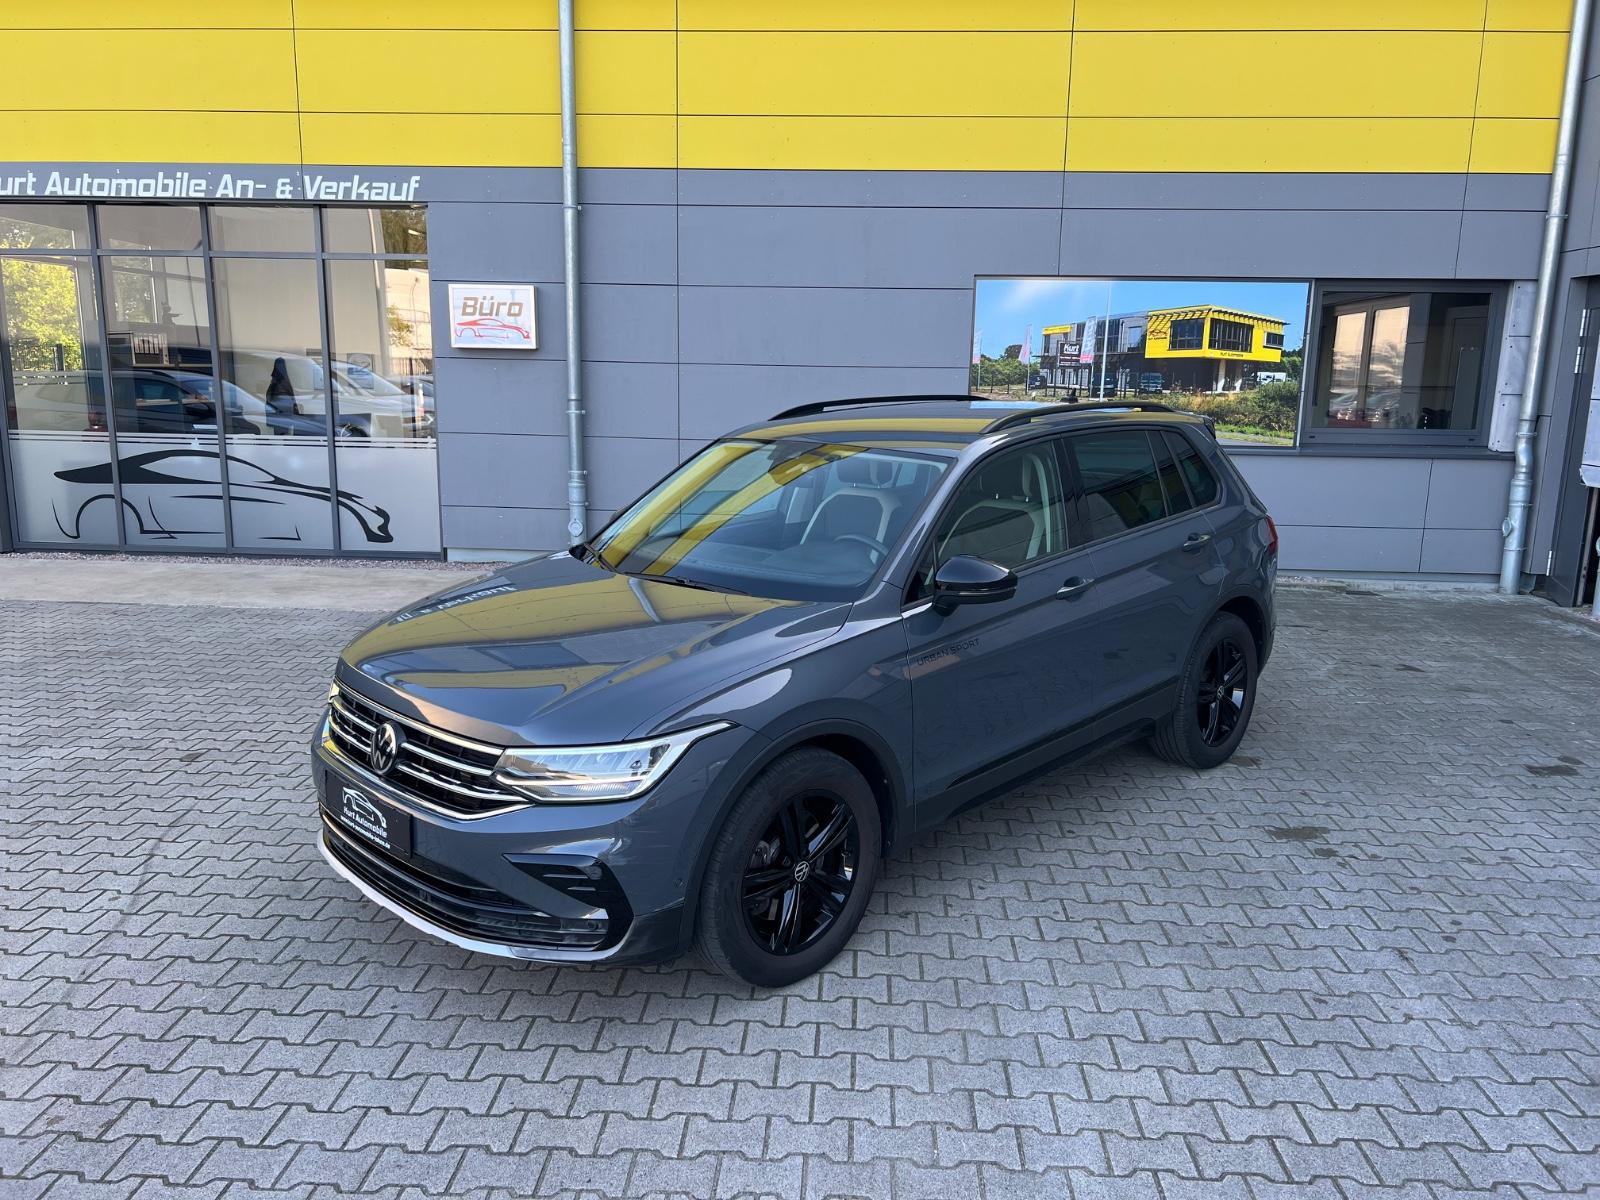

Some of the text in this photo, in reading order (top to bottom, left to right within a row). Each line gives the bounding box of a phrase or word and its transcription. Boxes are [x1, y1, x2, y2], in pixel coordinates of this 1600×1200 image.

[44, 171, 207, 198] Automobile
[215, 173, 267, 199] An-
[275, 178, 294, 200] &
[303, 174, 421, 201] Verkauf
[461, 295, 524, 318] Büro
[1063, 343, 1080, 352] Kurt
[917, 638, 980, 666] URBAN SPORT
[343, 806, 356, 820] Kurt
[355, 813, 388, 838] Automobile
